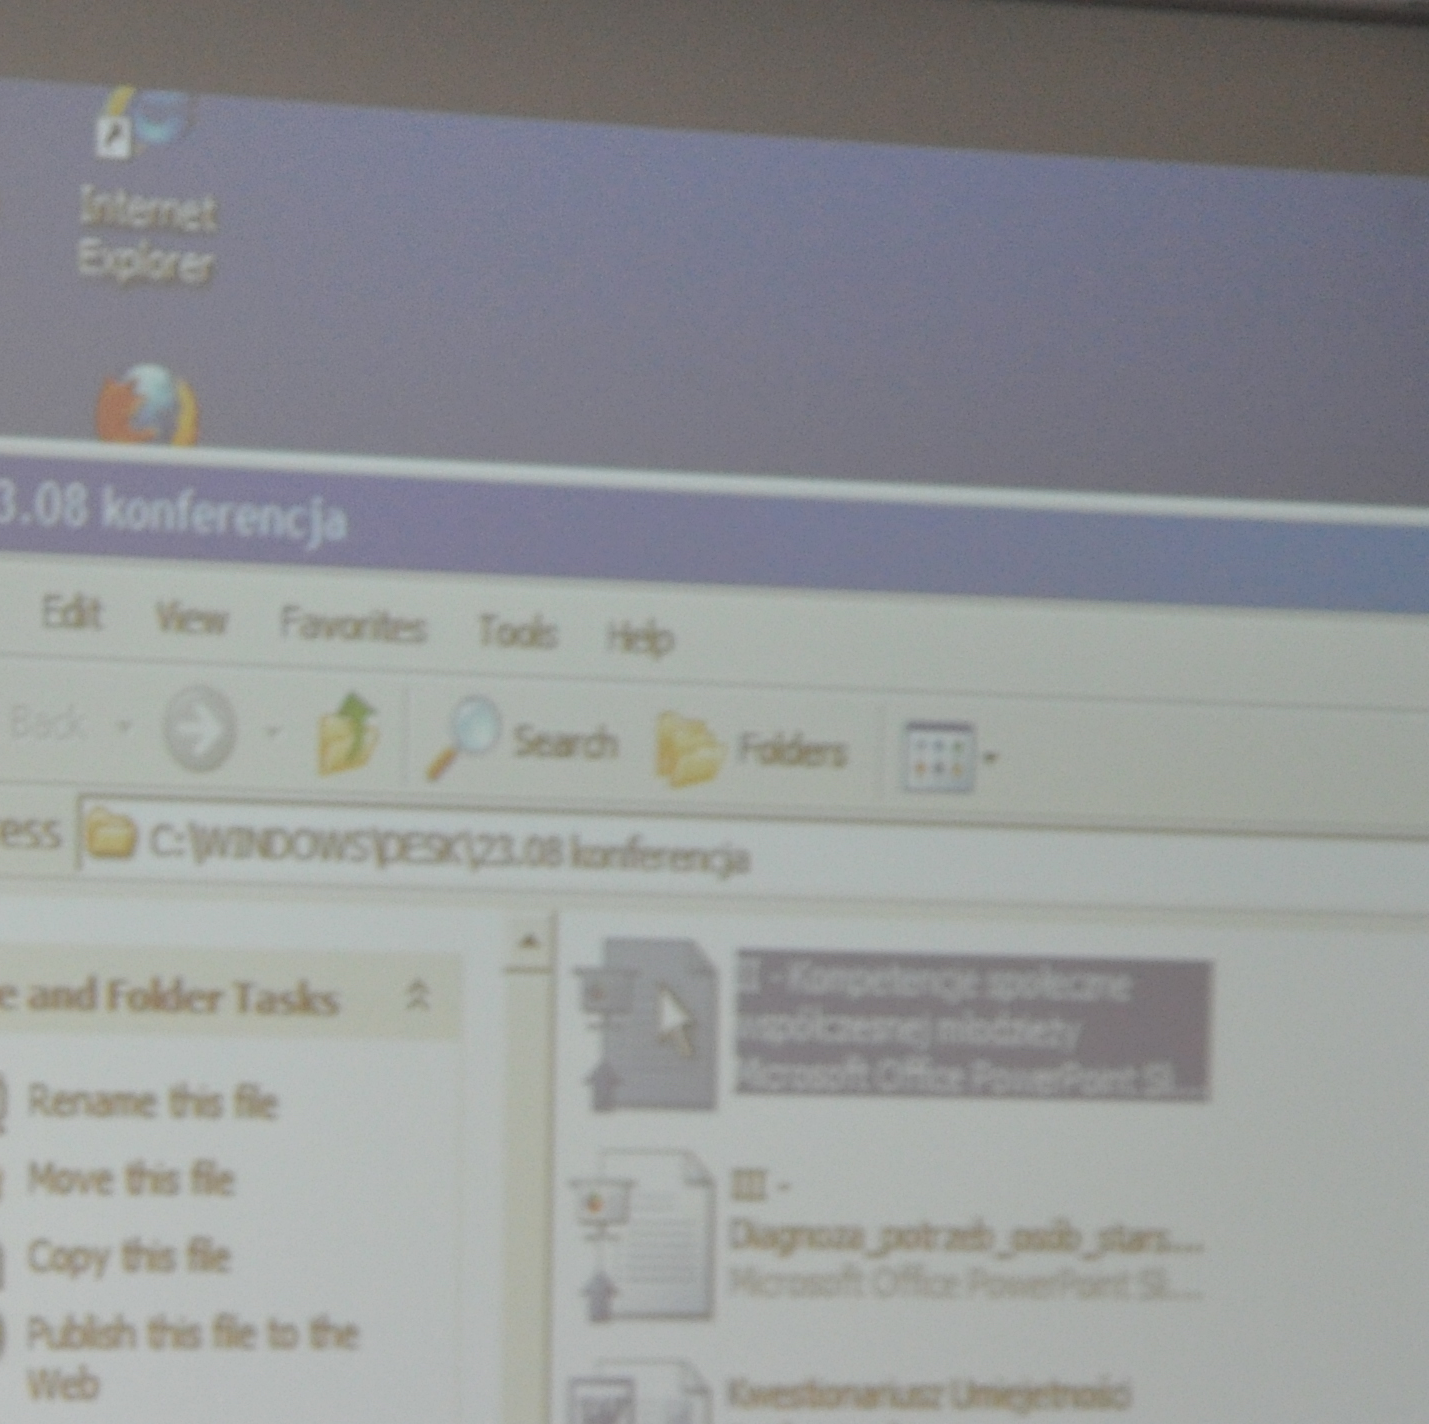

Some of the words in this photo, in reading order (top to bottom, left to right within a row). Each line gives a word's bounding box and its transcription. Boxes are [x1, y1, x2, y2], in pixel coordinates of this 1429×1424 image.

[79, 184, 219, 233] Internet
[77, 238, 216, 285] Explorer
[102, 482, 349, 550] konferencja
[42, 592, 103, 632] Edit
[156, 598, 229, 637] View
[280, 604, 430, 645] Favorites
[479, 611, 560, 651] Tools
[607, 616, 675, 662] Help
[512, 722, 619, 762] Search
[740, 730, 848, 769] Folders
[570, 837, 752, 882] konferencja
[27, 976, 95, 1014] and
[106, 977, 223, 1017] Folder
[233, 980, 340, 1019] Tasks
[27, 1083, 157, 1121] Rename
[168, 1083, 225, 1120] this
[233, 1083, 280, 1121] file
[27, 1160, 114, 1198] Move
[125, 1158, 181, 1197] this
[191, 1157, 236, 1197] file
[27, 1238, 110, 1283] Copy
[122, 1235, 177, 1274] this
[186, 1235, 232, 1274] file
[27, 1314, 137, 1351] Publish
[147, 1314, 203, 1350] this
[212, 1314, 258, 1350] file
[267, 1315, 298, 1350] to
[309, 1314, 361, 1350] the
[27, 1365, 100, 1402] Web
